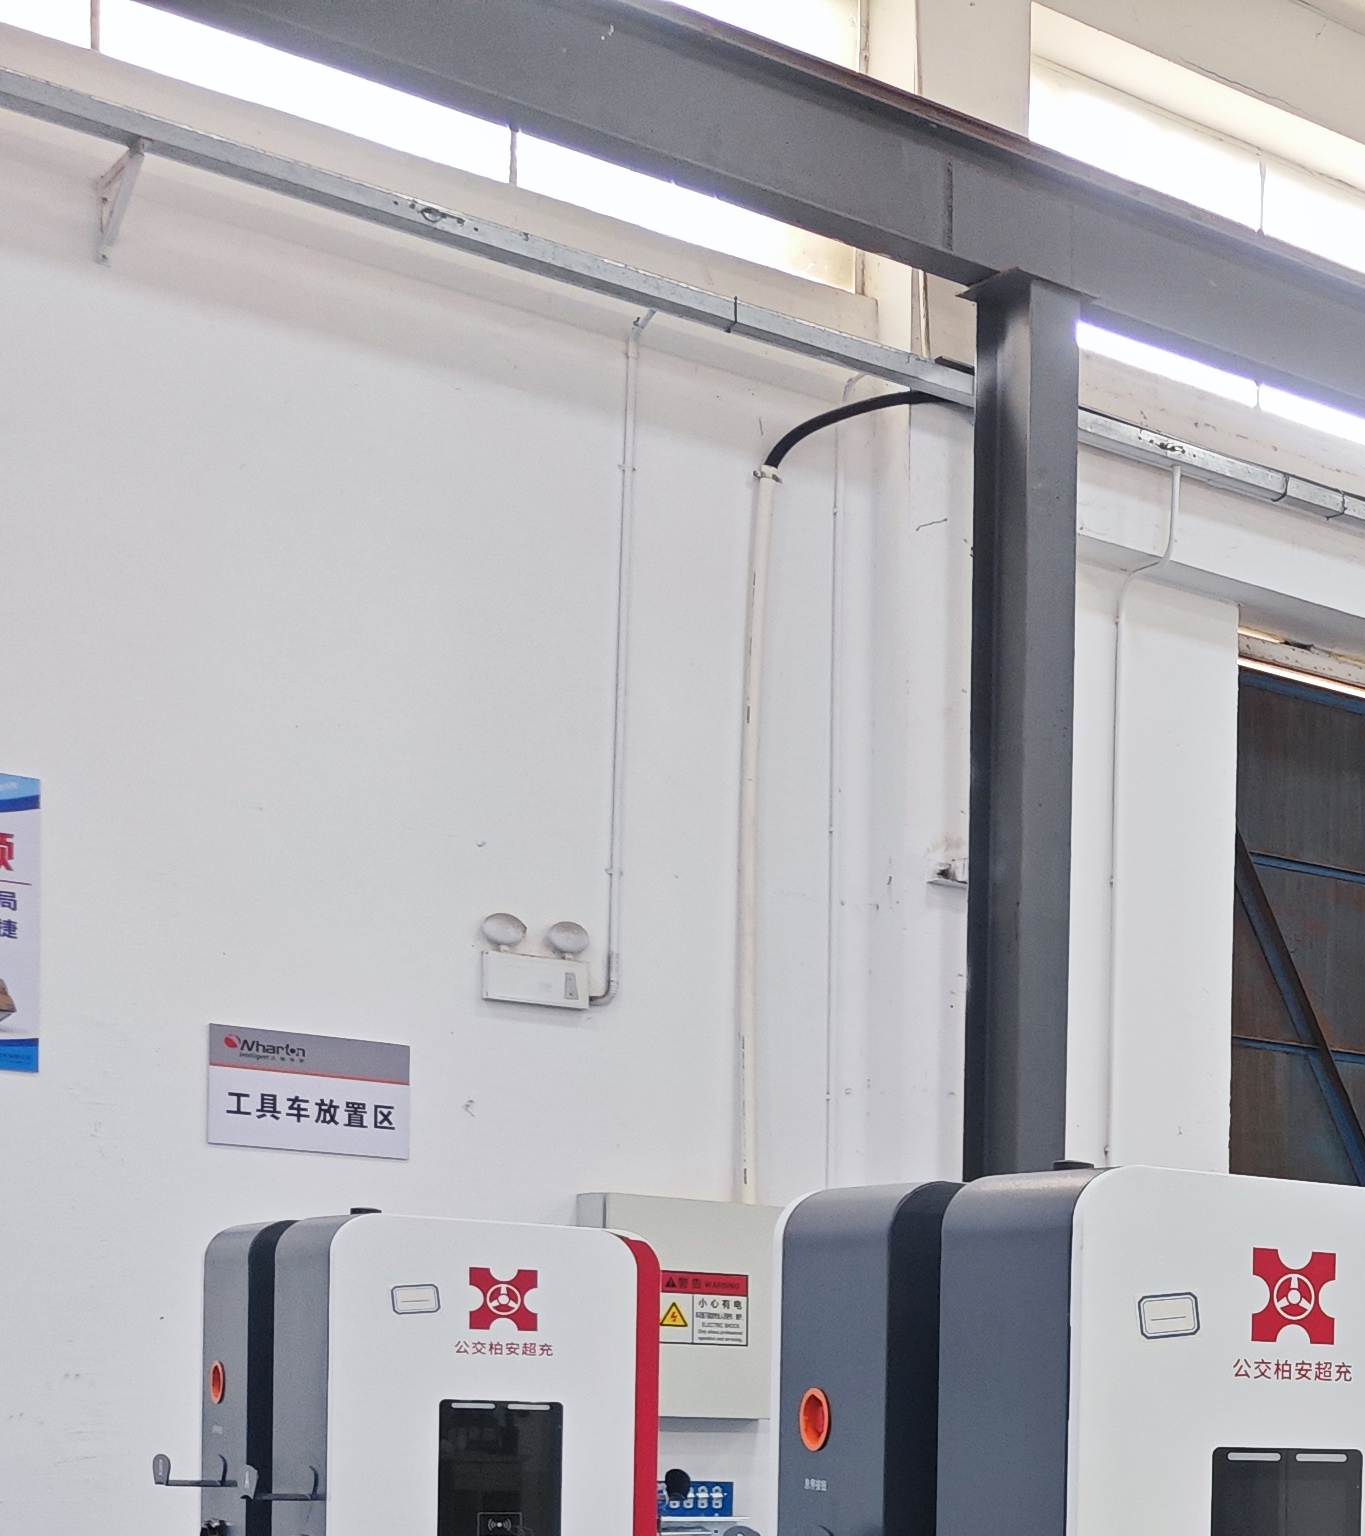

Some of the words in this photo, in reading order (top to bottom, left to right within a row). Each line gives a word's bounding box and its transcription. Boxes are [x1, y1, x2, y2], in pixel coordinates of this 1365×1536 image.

[226, 1091, 396, 1131] 工具车放置区
[454, 1340, 554, 1357] 公交柏安超充
[1232, 1358, 1353, 1382] 公交柏安超充
